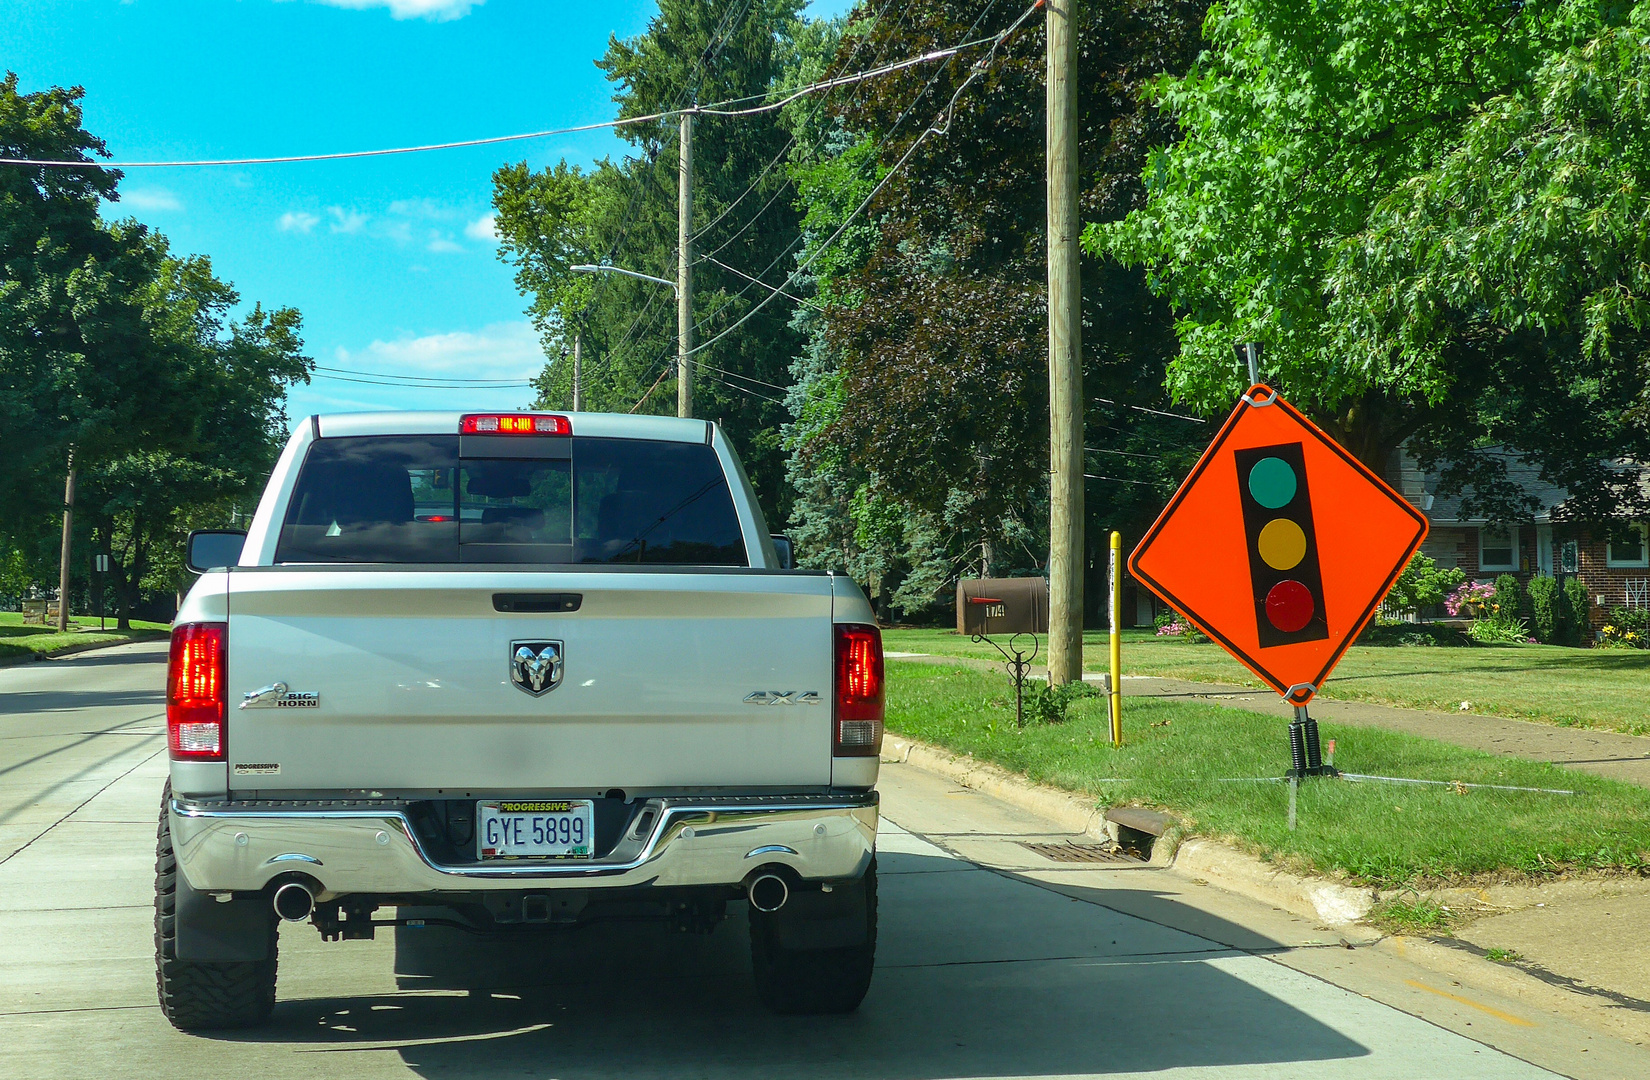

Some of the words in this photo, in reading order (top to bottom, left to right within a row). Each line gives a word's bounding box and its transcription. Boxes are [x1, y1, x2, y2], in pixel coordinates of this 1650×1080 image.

[501, 802, 568, 812] PROGRESSIVE
[487, 817, 525, 845] GYE
[532, 817, 584, 845] 5899
